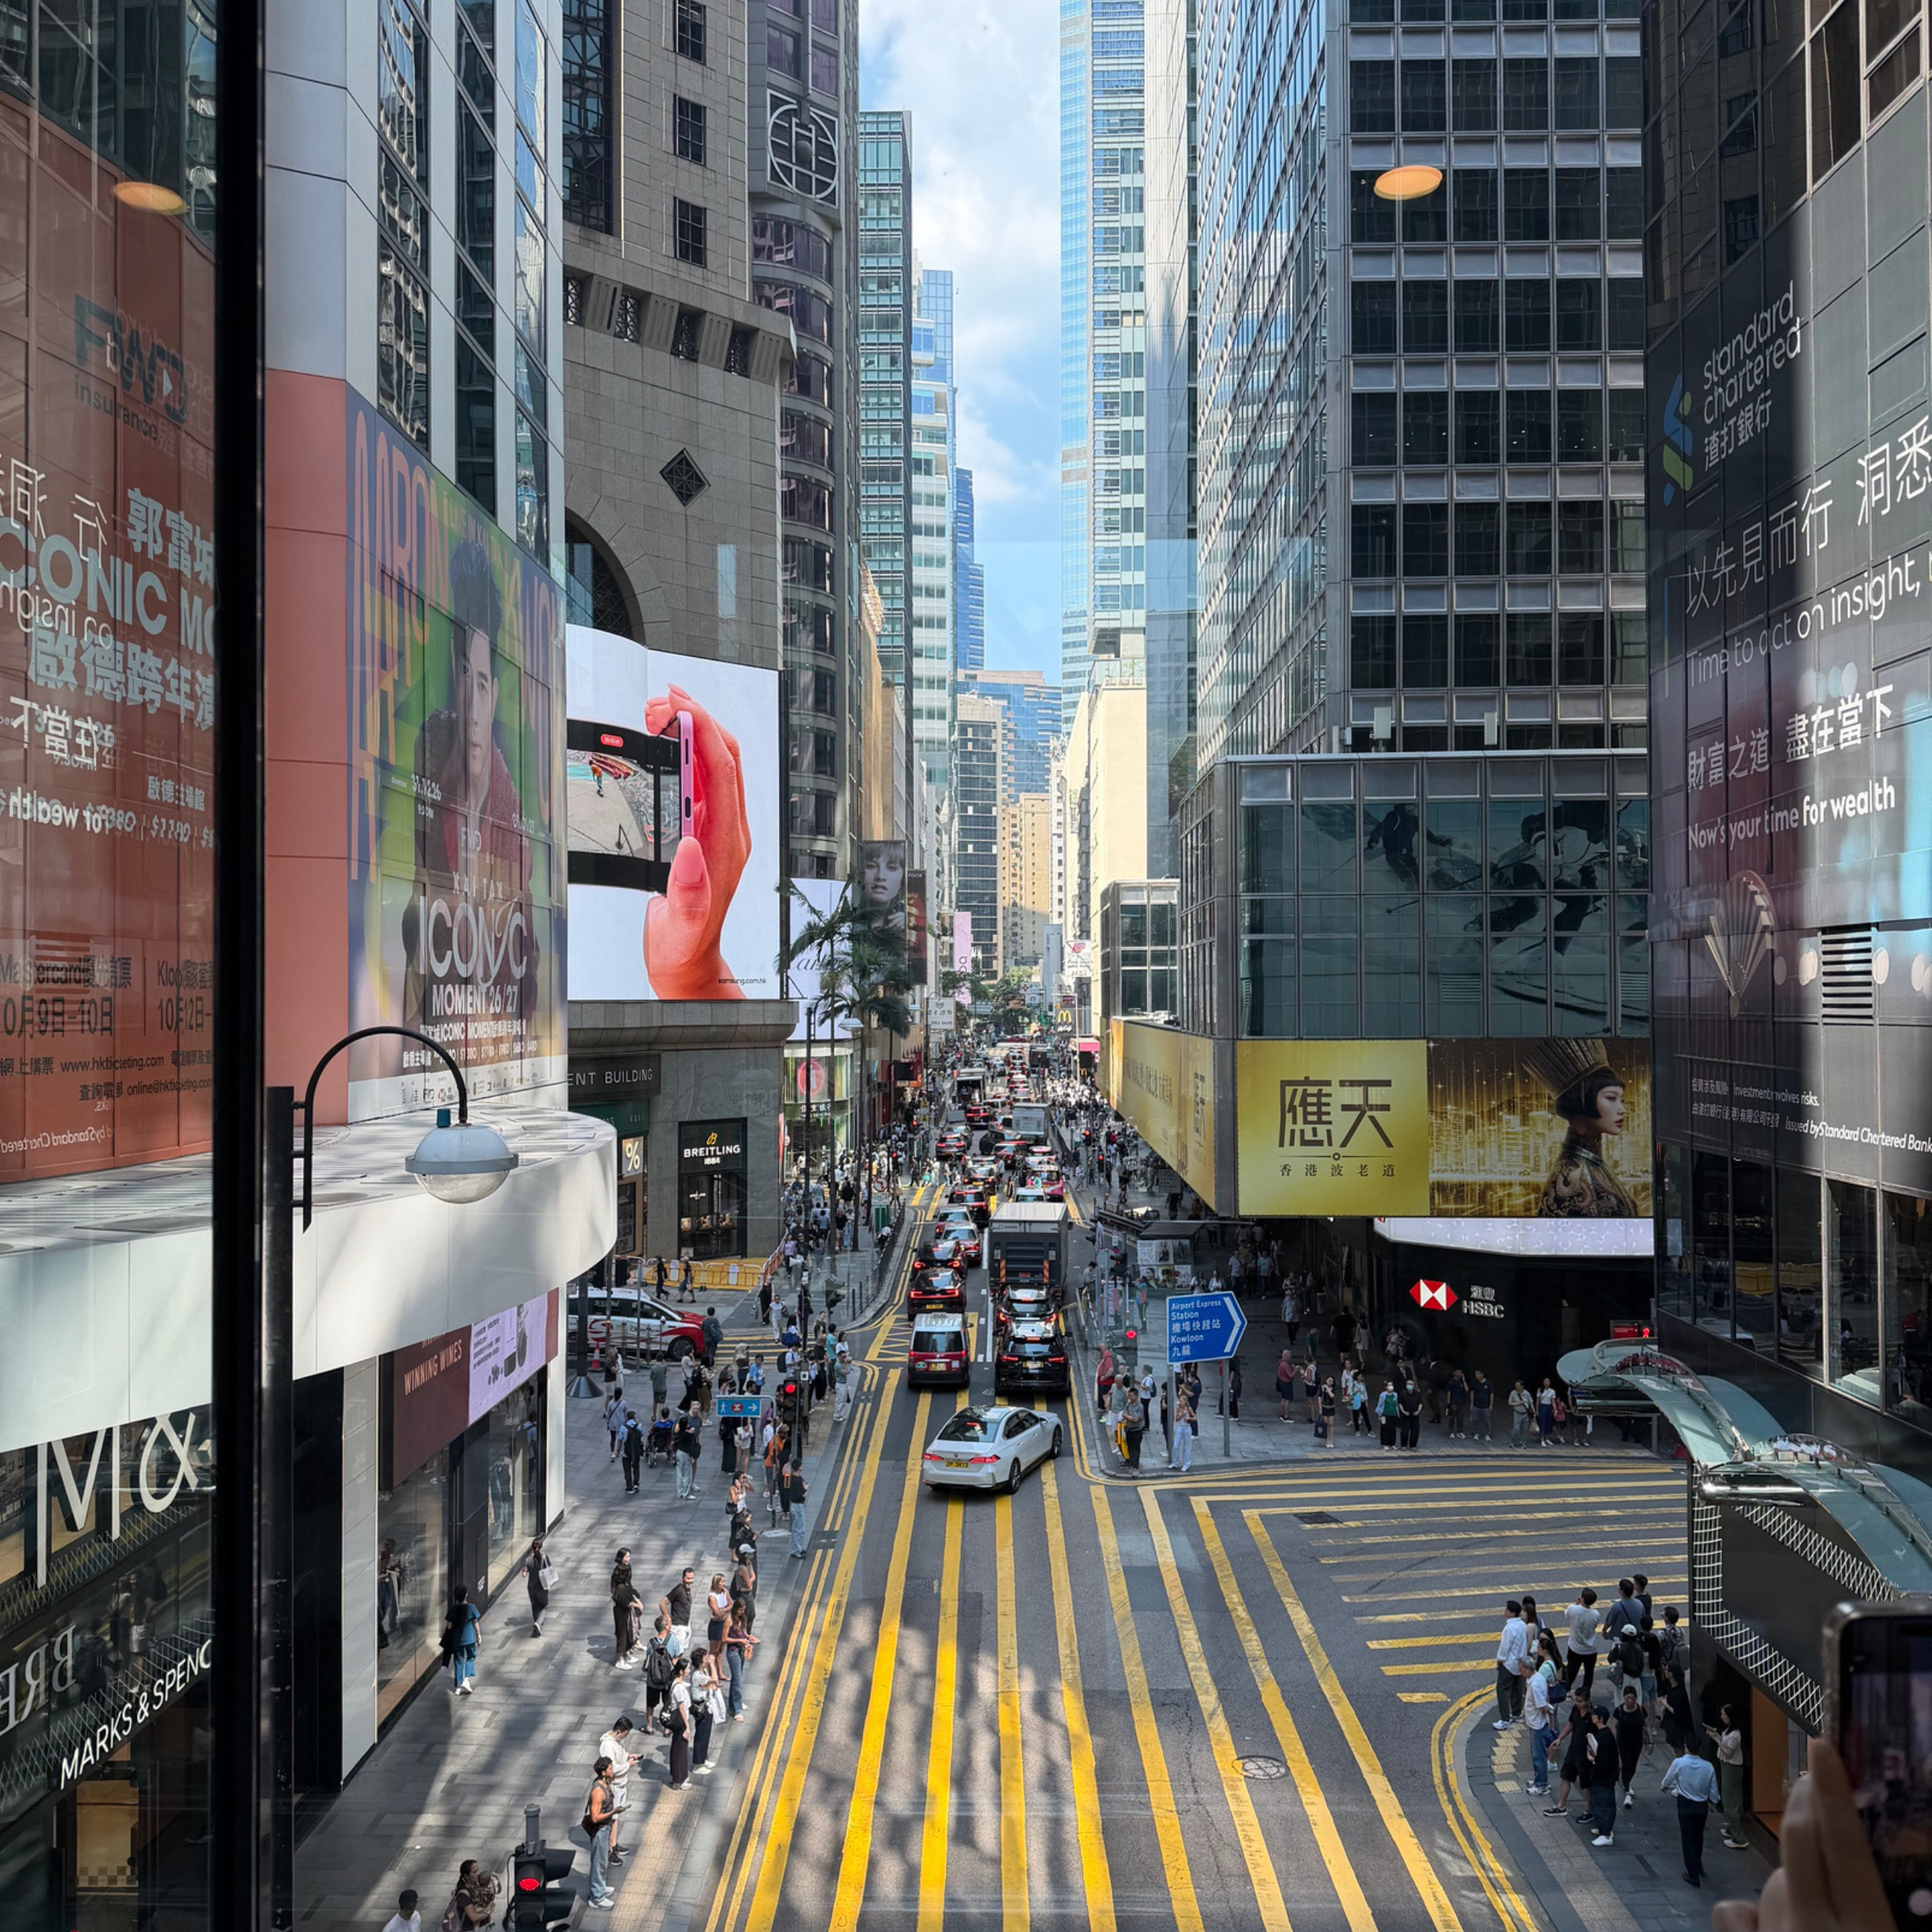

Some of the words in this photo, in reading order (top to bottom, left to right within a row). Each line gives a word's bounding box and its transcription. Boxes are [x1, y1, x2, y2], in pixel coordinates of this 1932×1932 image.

[1703, 279, 1794, 390] standard
[74, 292, 188, 425] FWD
[1703, 316, 1801, 425] chartered
[75, 374, 159, 443] insurance
[1703, 389, 1773, 472] 渣打銀行
[1685, 479, 1834, 618] 以先見而行
[1855, 414, 1932, 527] 洞悉
[1687, 648, 1730, 688] Time
[1734, 634, 1754, 667] to
[1759, 613, 1792, 657] act
[1796, 602, 1825, 639] on
[1830, 552, 1921, 626] insight,
[1687, 722, 1770, 793] 財富之道
[1786, 684, 1894, 763] 盡在當下
[1687, 817, 1726, 851] Now's
[1730, 815, 1762, 851] your
[1764, 804, 1799, 834] time
[1802, 795, 1826, 826] for
[1829, 776, 1896, 820] wealth
[460, 826, 482, 852] FWD
[419, 895, 528, 987] ICONIC
[432, 983, 487, 1017] MOMENT
[488, 984, 519, 1014] 26/27
[60, 1055, 165, 1073] www.hkticketing.com
[605, 1068, 653, 1084] BUILDING
[1278, 1075, 1395, 1149] 應天
[1800, 1090, 1820, 1107] risks.
[683, 1144, 741, 1158] BREITLING
[1785, 1116, 1810, 1134] Issued
[1820, 1121, 1860, 1142] Standard
[1860, 1126, 1907, 1149] Chartered
[704, 1156, 721, 1165] 1884
[1278, 1163, 1395, 1178] 香港波老道
[1171, 1302, 1195, 1310] Airport
[1196, 1300, 1221, 1308] Express
[1171, 1311, 1199, 1320] Station
[1461, 1299, 1505, 1319] HSBC
[1171, 1334, 1204, 1343] Kowloon
[404, 1354, 438, 1396] WINNING
[439, 1338, 463, 1373] WINES
[60, 1703, 133, 1791] MARKS
[136, 1690, 150, 1724] &
